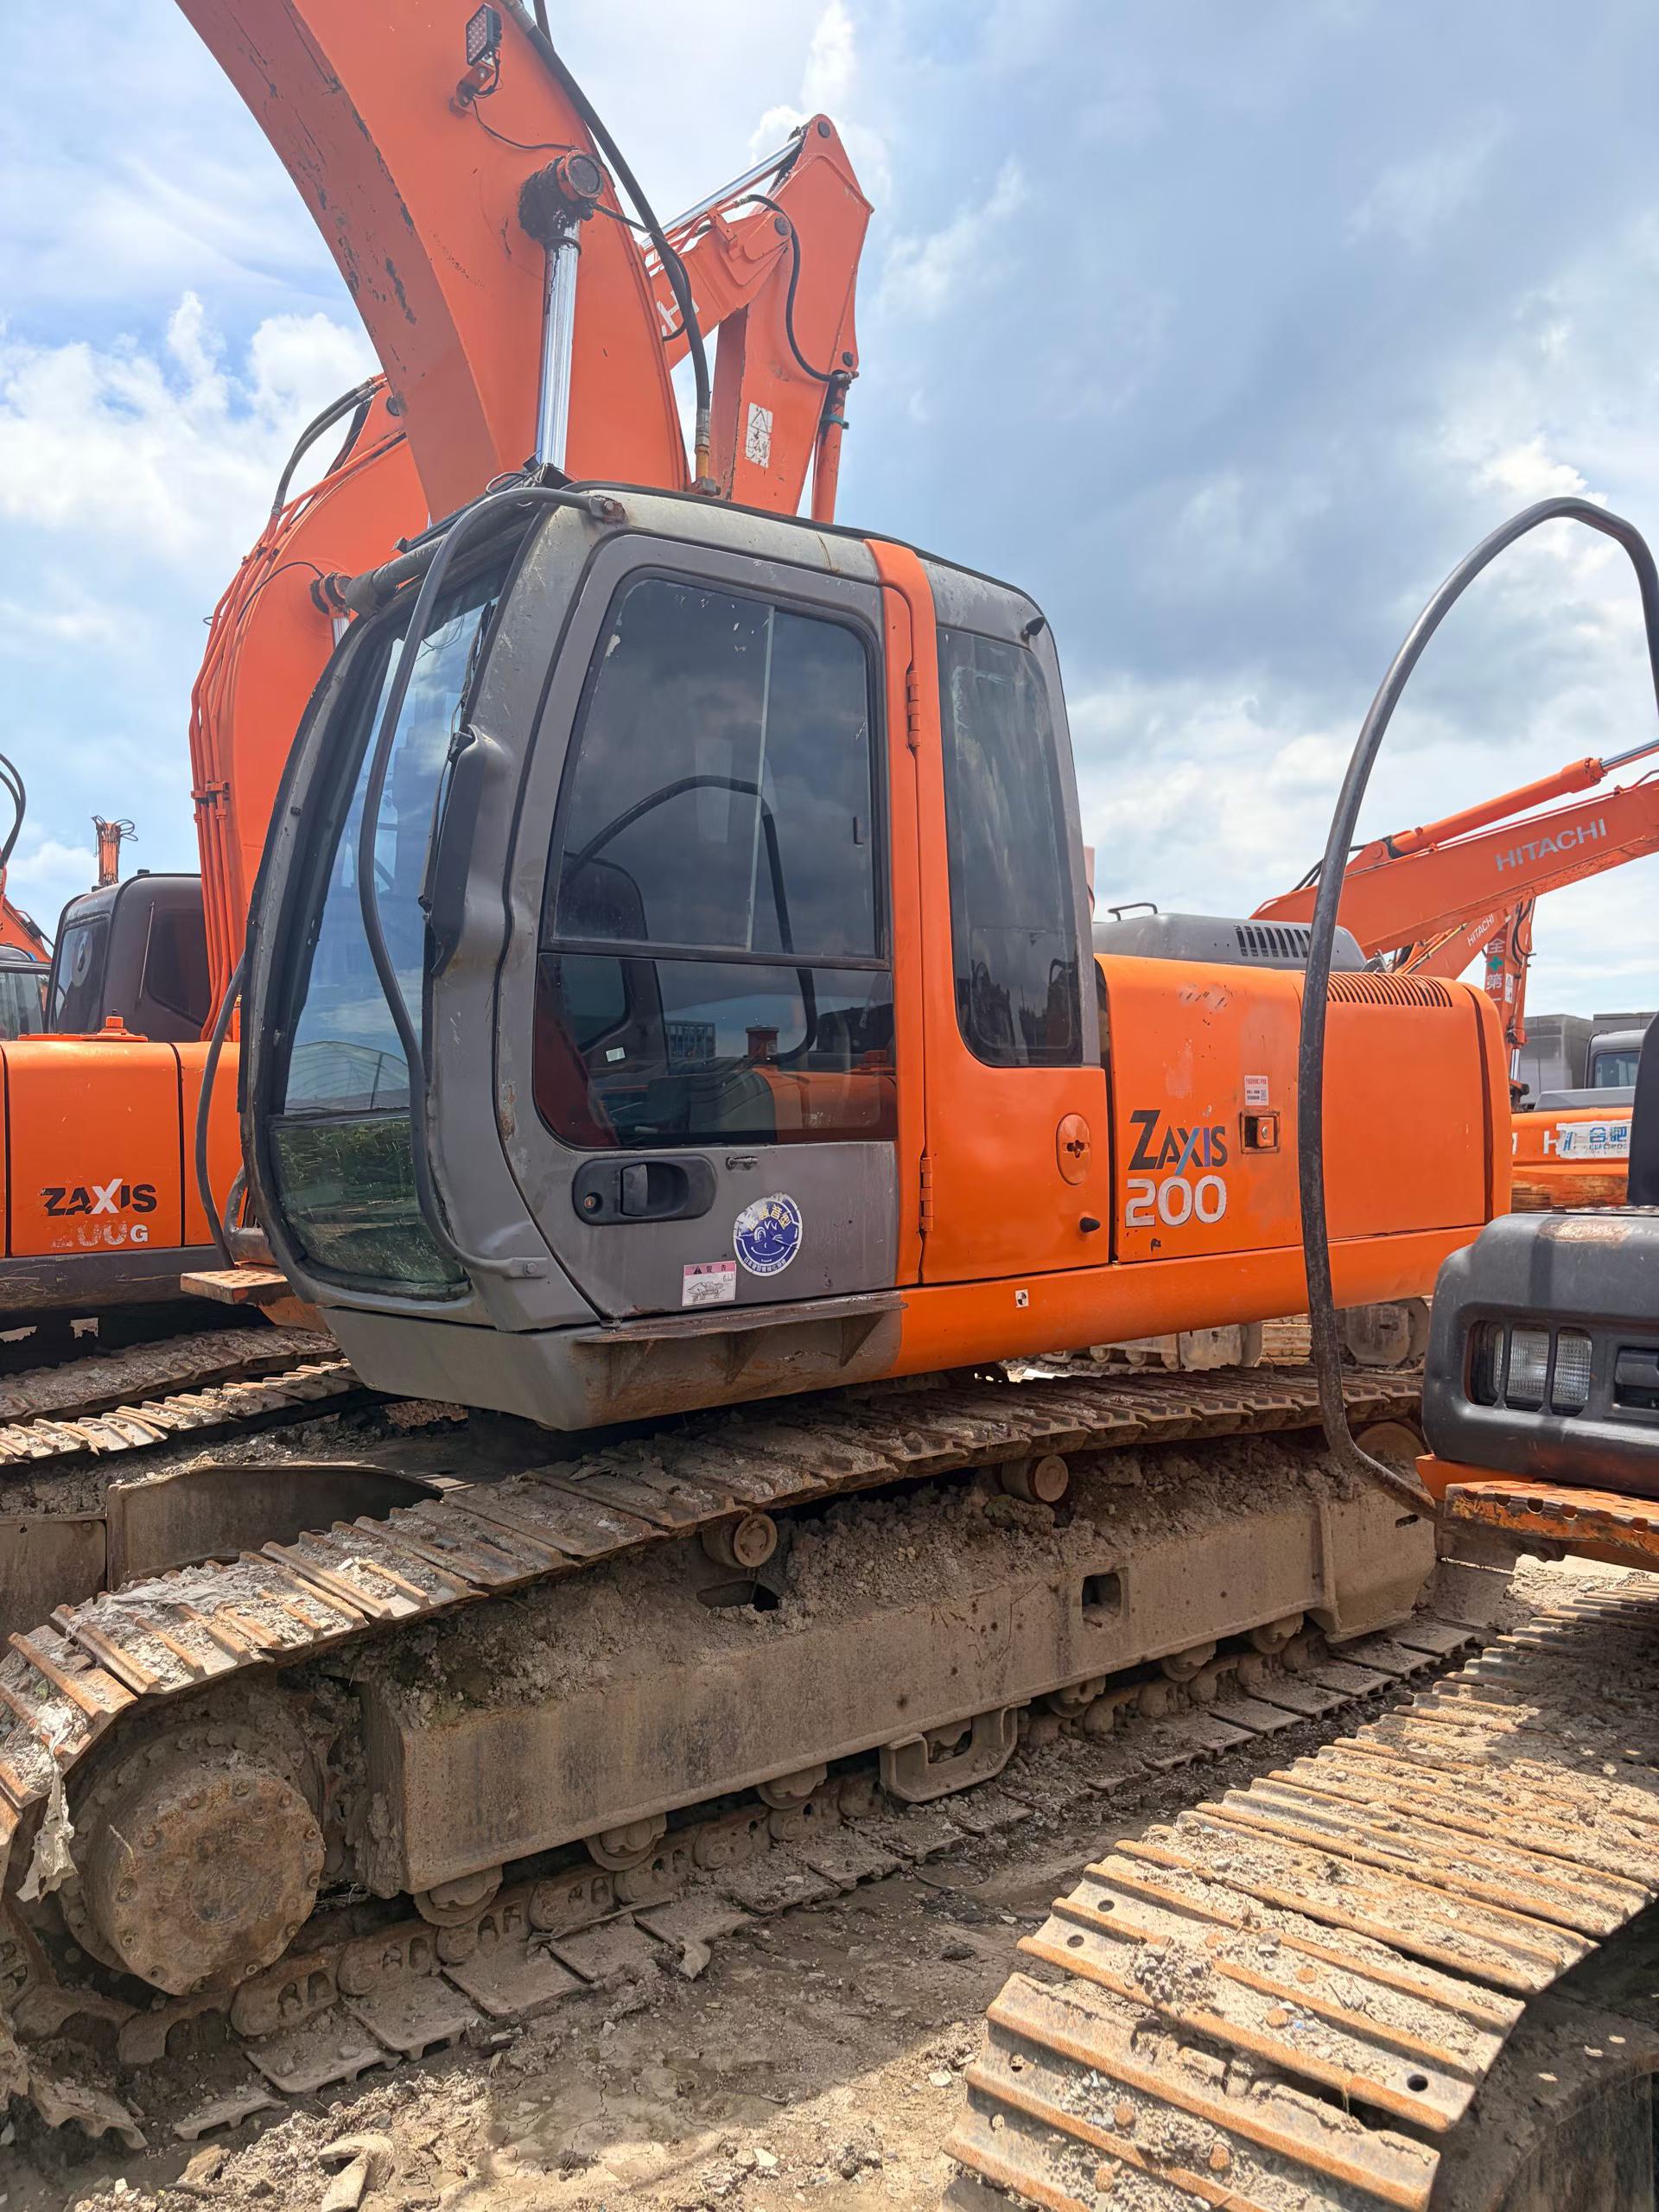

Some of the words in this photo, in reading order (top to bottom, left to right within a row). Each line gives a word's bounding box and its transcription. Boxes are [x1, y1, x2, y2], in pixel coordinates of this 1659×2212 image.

[1494, 817, 1607, 872] HITACHI
[1467, 913, 1495, 947] HITACHI
[1128, 1109, 1228, 1176] ZAXIS
[41, 1179, 157, 1217] ZAXIS
[1125, 1175, 1227, 1228] 200
